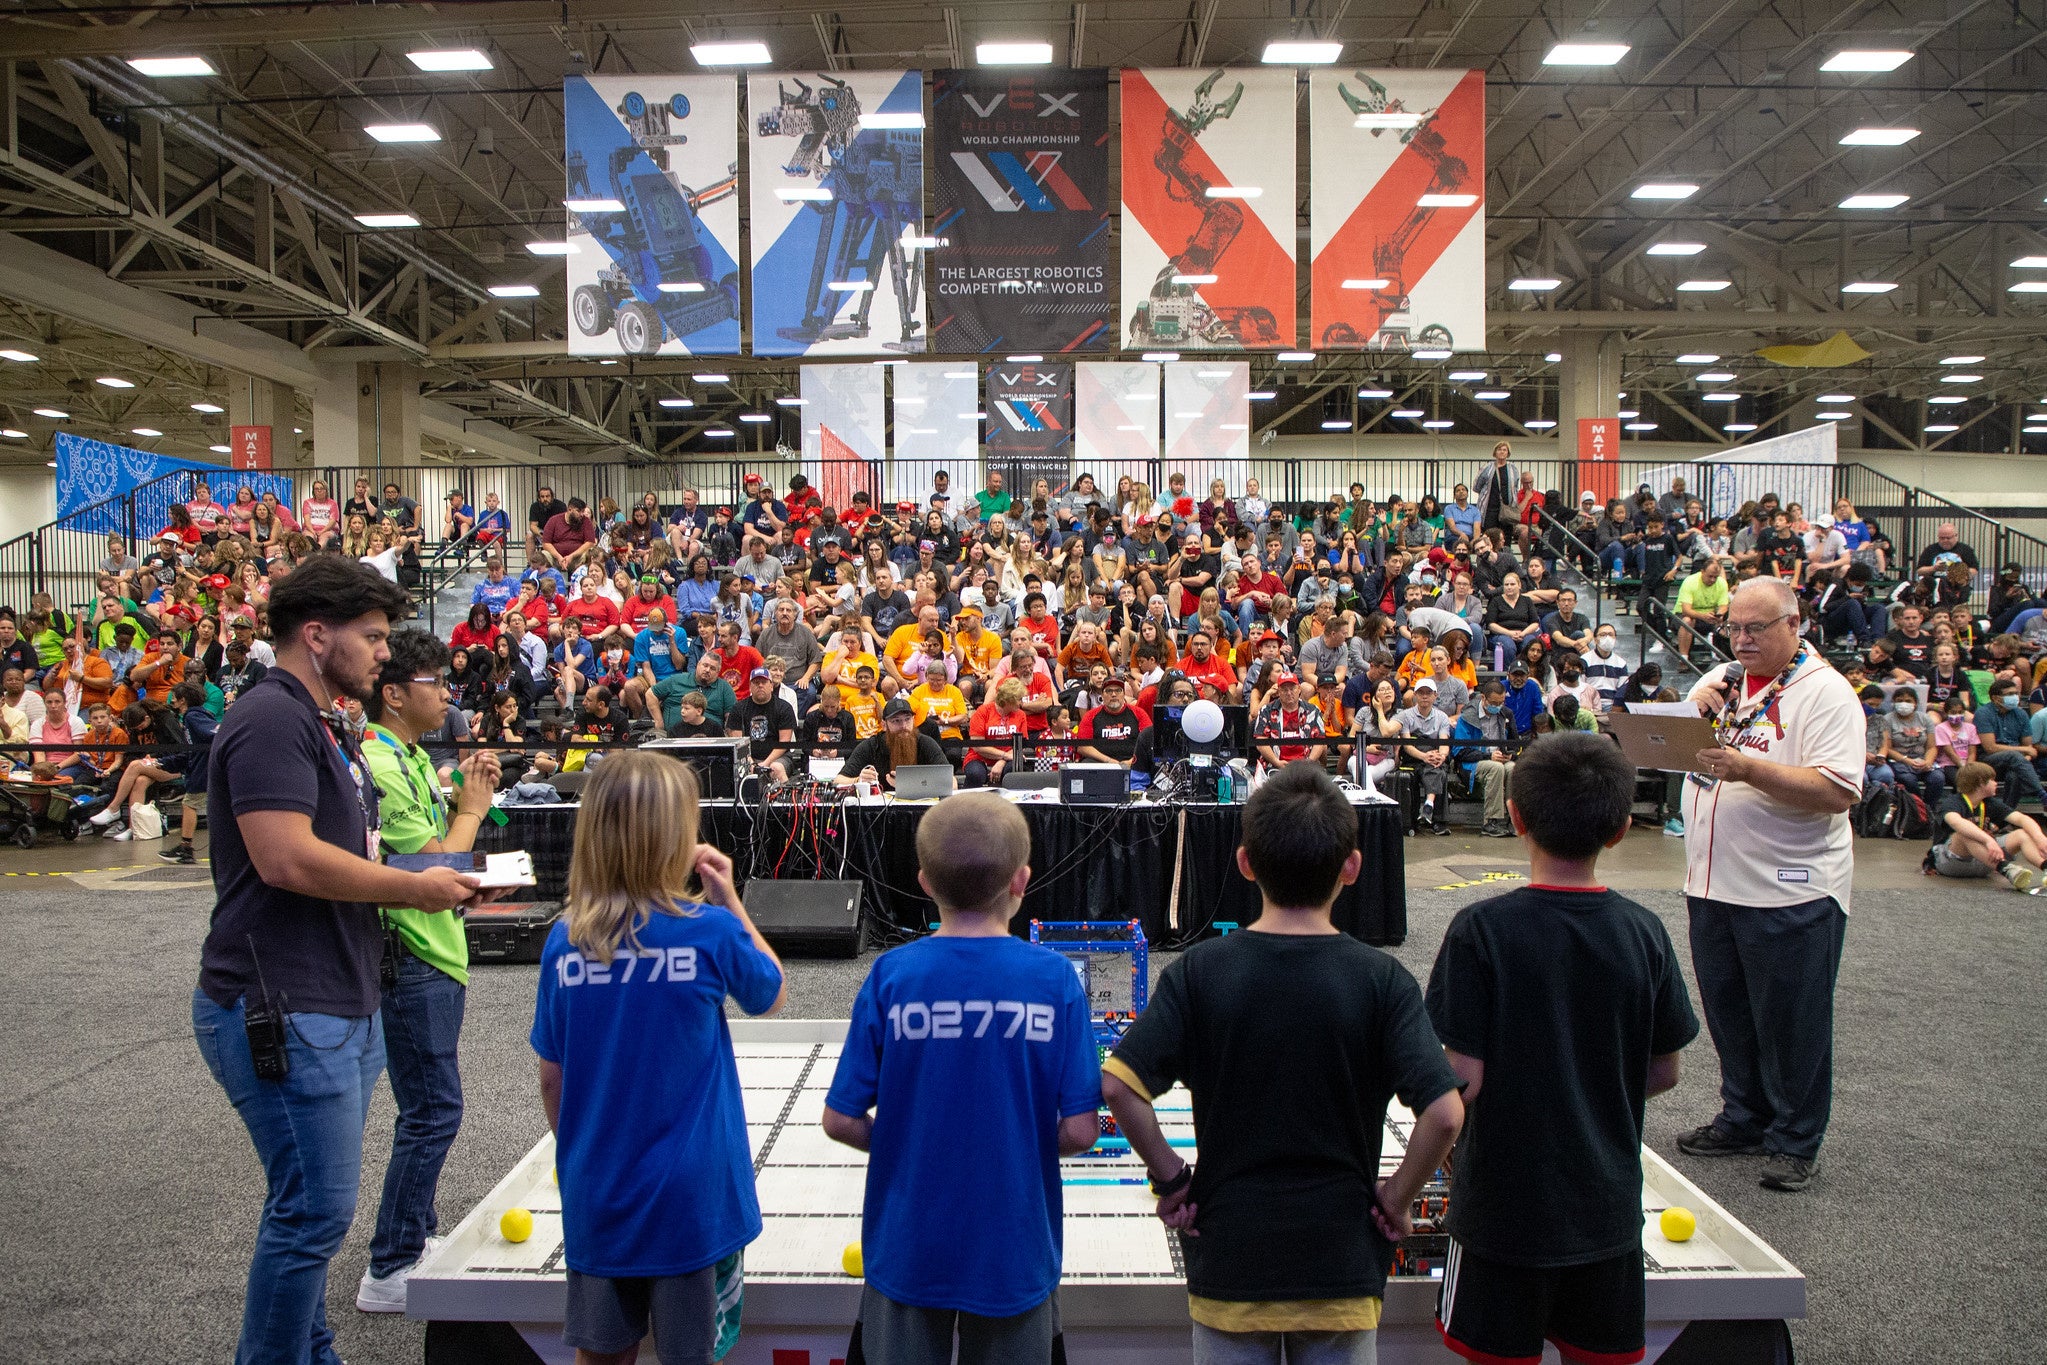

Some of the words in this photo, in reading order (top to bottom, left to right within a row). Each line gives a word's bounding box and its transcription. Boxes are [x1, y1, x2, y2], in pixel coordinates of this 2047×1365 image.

[962, 77, 1080, 118] VEX
[962, 136, 999, 144] WORLD
[1002, 135, 1080, 144] CHAMPIONSHIP
[939, 267, 966, 279] THE
[970, 267, 1030, 279] LARGEST
[1034, 266, 1103, 279] ROBOTICS
[939, 281, 1036, 294] COMPETITION
[1051, 282, 1103, 293] WORLD
[1000, 366, 1057, 386] VEX
[245, 432, 257, 469] MATH
[1591, 425, 1605, 461] MATH
[384, 811, 406, 825] VEX
[556, 947, 697, 988] 10277B
[888, 1000, 1055, 1043] 10277B
